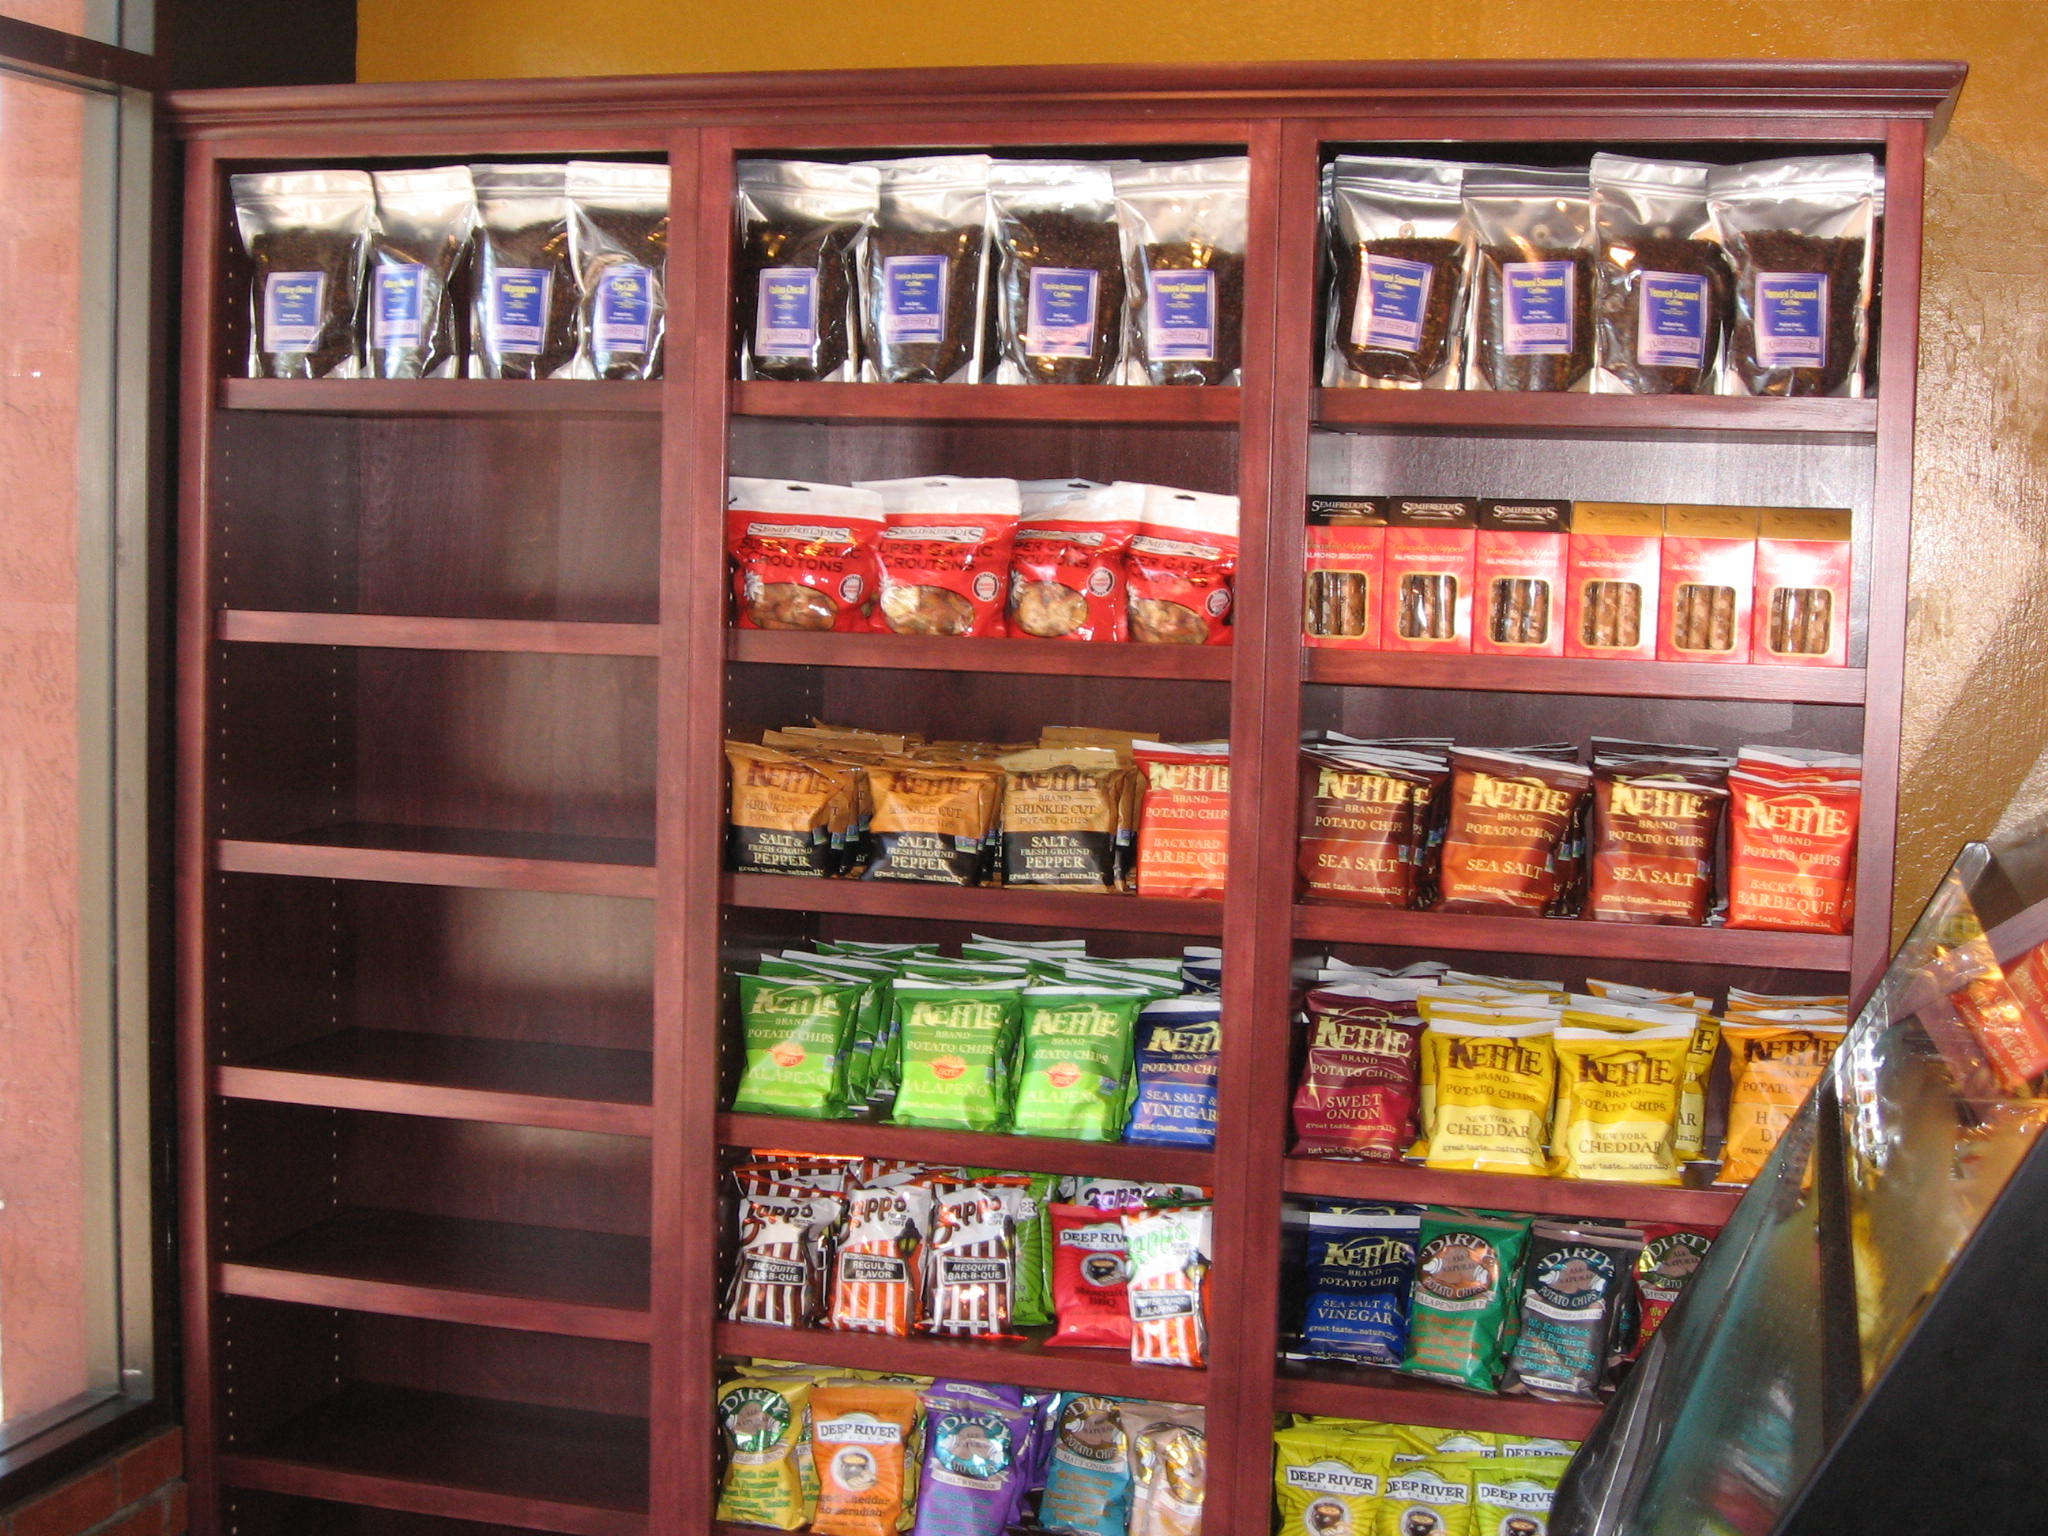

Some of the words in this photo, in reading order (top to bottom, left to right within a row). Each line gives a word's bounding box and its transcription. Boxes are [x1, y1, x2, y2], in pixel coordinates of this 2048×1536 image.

[1173, 795, 1209, 803] BRAND
[1465, 772, 1571, 816] KETTLE
[1605, 782, 1708, 818] KETTLE
[1015, 805, 1069, 814] KRINKLE
[1071, 805, 1096, 814] CUT
[1146, 807, 1192, 816] POTATO
[1345, 805, 1381, 814] BRAND
[1745, 792, 1849, 837] KETTLE
[1020, 816, 1057, 824] POTATO
[1060, 816, 1089, 825] CHIPS
[1315, 817, 1367, 830] POTATO
[1497, 813, 1534, 822] BRAND
[1466, 823, 1517, 837] POTATO
[1639, 820, 1678, 829] BRAND
[759, 833, 792, 847] SALT
[794, 837, 805, 847] &
[898, 836, 931, 849] SALT
[935, 841, 944, 849] &
[1031, 836, 1066, 848] SALT
[1069, 839, 1080, 848] &
[1154, 838, 1220, 848] BACKYARD
[1608, 831, 1661, 844] POTATO
[1666, 834, 1704, 847] CHIPS
[1773, 835, 1811, 846] BRAND
[749, 844, 775, 852] FRESH
[776, 845, 812, 854] GROUND
[887, 847, 914, 856] FRESH
[916, 848, 954, 858] GROUND
[1050, 848, 1090, 856] GROUND
[1743, 845, 1795, 861] POTATO
[1799, 851, 1840, 866] CHIPS
[754, 852, 811, 866] PEPPER
[891, 856, 947, 870] PEPPER
[1025, 856, 1086, 868] PEPPER
[1319, 854, 1349, 870] SEA
[1356, 856, 1398, 873] SALT
[1466, 859, 1499, 872] SEA
[1503, 861, 1543, 879] SALT
[1009, 872, 1030, 880] great
[1613, 867, 1646, 881] SEA
[1651, 871, 1695, 887] SALT
[1751, 880, 1824, 897] BACKYARD
[1737, 891, 1834, 916] BARBEQUE
[750, 985, 841, 1017] KETTLE
[907, 999, 1001, 1028] KETTLE
[1030, 1003, 1119, 1036] KETTLE
[748, 1029, 792, 1039] POTATO
[798, 1032, 834, 1043] CHIPS
[935, 1031, 969, 1039] BRAND
[1312, 1016, 1412, 1057] KETTLE
[907, 1041, 955, 1051] POTATO
[959, 1044, 996, 1054] CHIPS
[1074, 1051, 1109, 1064] CHIPS
[1341, 1055, 1377, 1064] BRAND
[1448, 1038, 1544, 1077] KETTLE
[1141, 1063, 1189, 1073] POTATO
[1194, 1065, 1217, 1075] CHI
[1313, 1066, 1362, 1077] POTATO
[1576, 1050, 1672, 1086] KETTLE
[1475, 1073, 1510, 1084] BRAND
[1147, 1090, 1172, 1100] SEA
[1174, 1093, 1205, 1103] SALT
[1446, 1083, 1495, 1096] POTATO
[1499, 1089, 1536, 1103] CHIPS
[1604, 1088, 1642, 1098] BRAND
[1326, 1094, 1382, 1108] SWEET
[1631, 1100, 1666, 1112] CHIPS
[1326, 1107, 1380, 1120] ONION
[1446, 1122, 1529, 1138] CHEDDAR
[1596, 1132, 1616, 1140] NEW
[1620, 1132, 1647, 1140] YORK
[1578, 1140, 1662, 1154] CHEDDAR
[1063, 1232, 1098, 1242] DEEP
[1101, 1233, 1128, 1243] RIV
[1320, 1235, 1411, 1267] KETTLE
[752, 1262, 797, 1273] MESQUITE
[853, 1261, 895, 1270] REGULAR
[952, 1263, 1000, 1271] MESQUITE
[748, 1270, 798, 1281] BAR-B-QUE
[856, 1270, 892, 1279] FLAVOR
[948, 1272, 1000, 1280] BAR-B-QUE
[1320, 1278, 1367, 1286] POTATO
[1424, 1277, 1453, 1297] POTATO
[1456, 1287, 1485, 1297] CHIPS
[1539, 1287, 1570, 1307] POTATO
[1572, 1291, 1597, 1306] CHIPS
[1350, 1300, 1380, 1308] SALT
[1384, 1302, 1392, 1310] &
[1318, 1308, 1392, 1325] VINEGAR
[821, 1424, 852, 1436] DEEP
[855, 1425, 897, 1437] RIVER
[1067, 1435, 1092, 1456] POTATO
[1290, 1470, 1325, 1481] DEEP
[1328, 1474, 1373, 1490] RIVER
[1386, 1481, 1418, 1493] DEEP
[1421, 1484, 1464, 1499] RIVER
[1481, 1487, 1517, 1499] DEEP
[1520, 1493, 1555, 1502] RIVE
